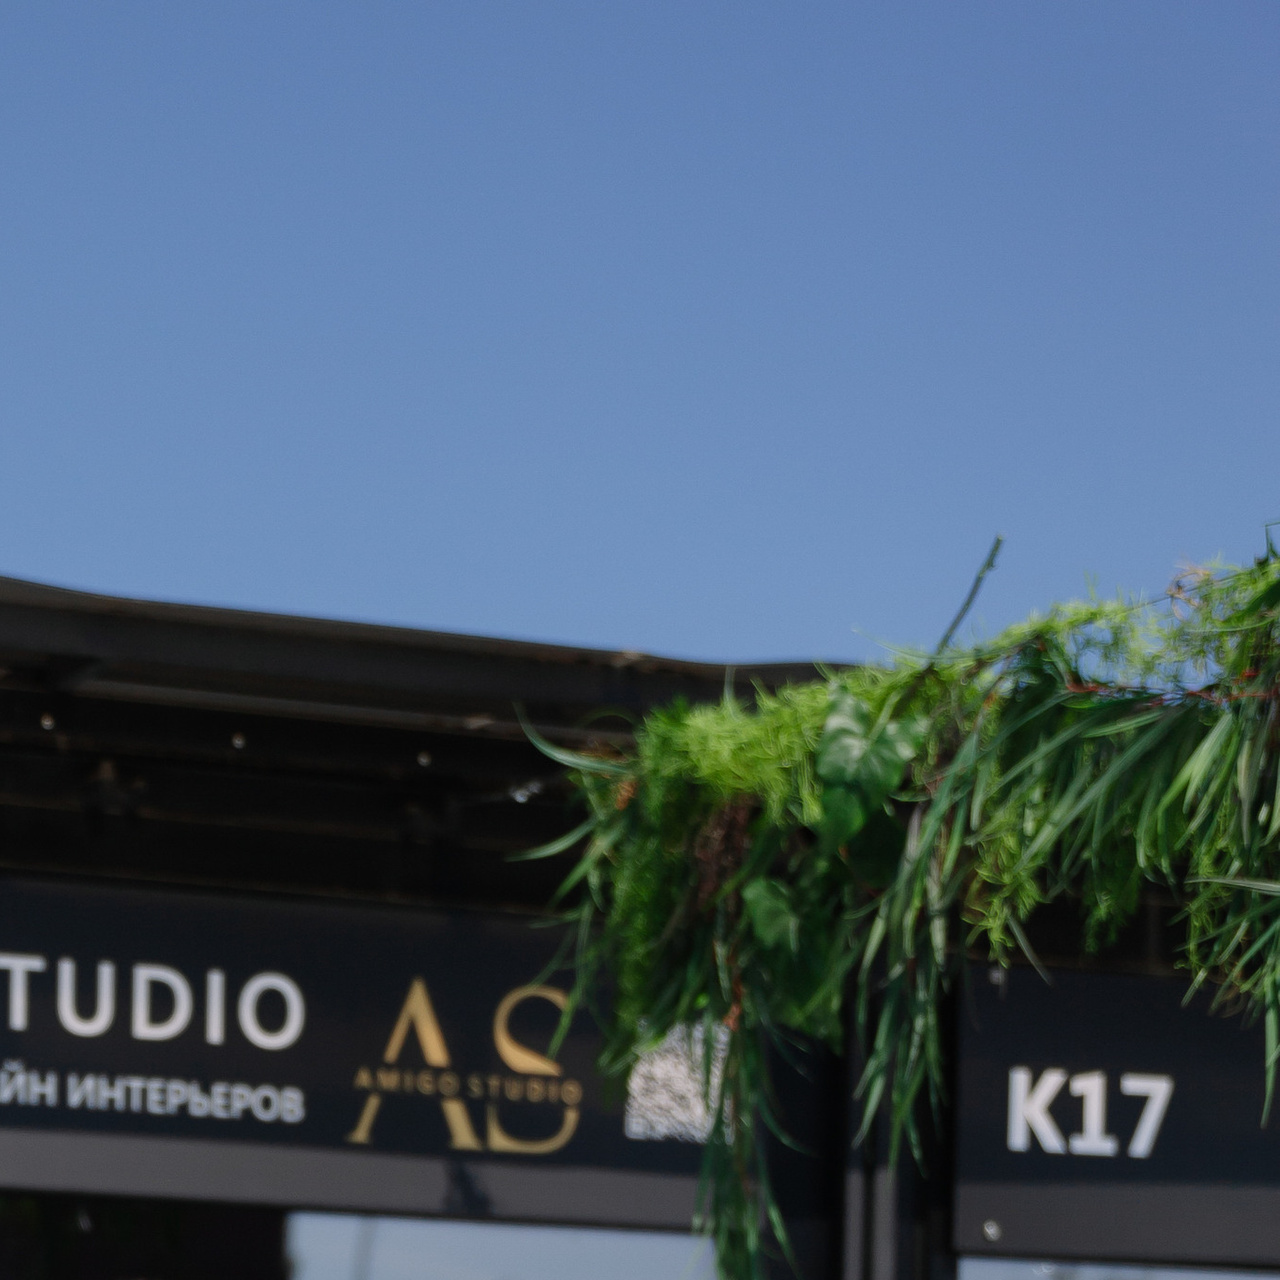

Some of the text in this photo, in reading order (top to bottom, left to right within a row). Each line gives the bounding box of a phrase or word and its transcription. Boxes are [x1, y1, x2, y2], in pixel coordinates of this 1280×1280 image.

[66, 1073, 306, 1123] ИНТЕРЬЕРОВ
[354, 1066, 583, 1106] AMIGO STUDIO
[1006, 1065, 1175, 1159] K17
